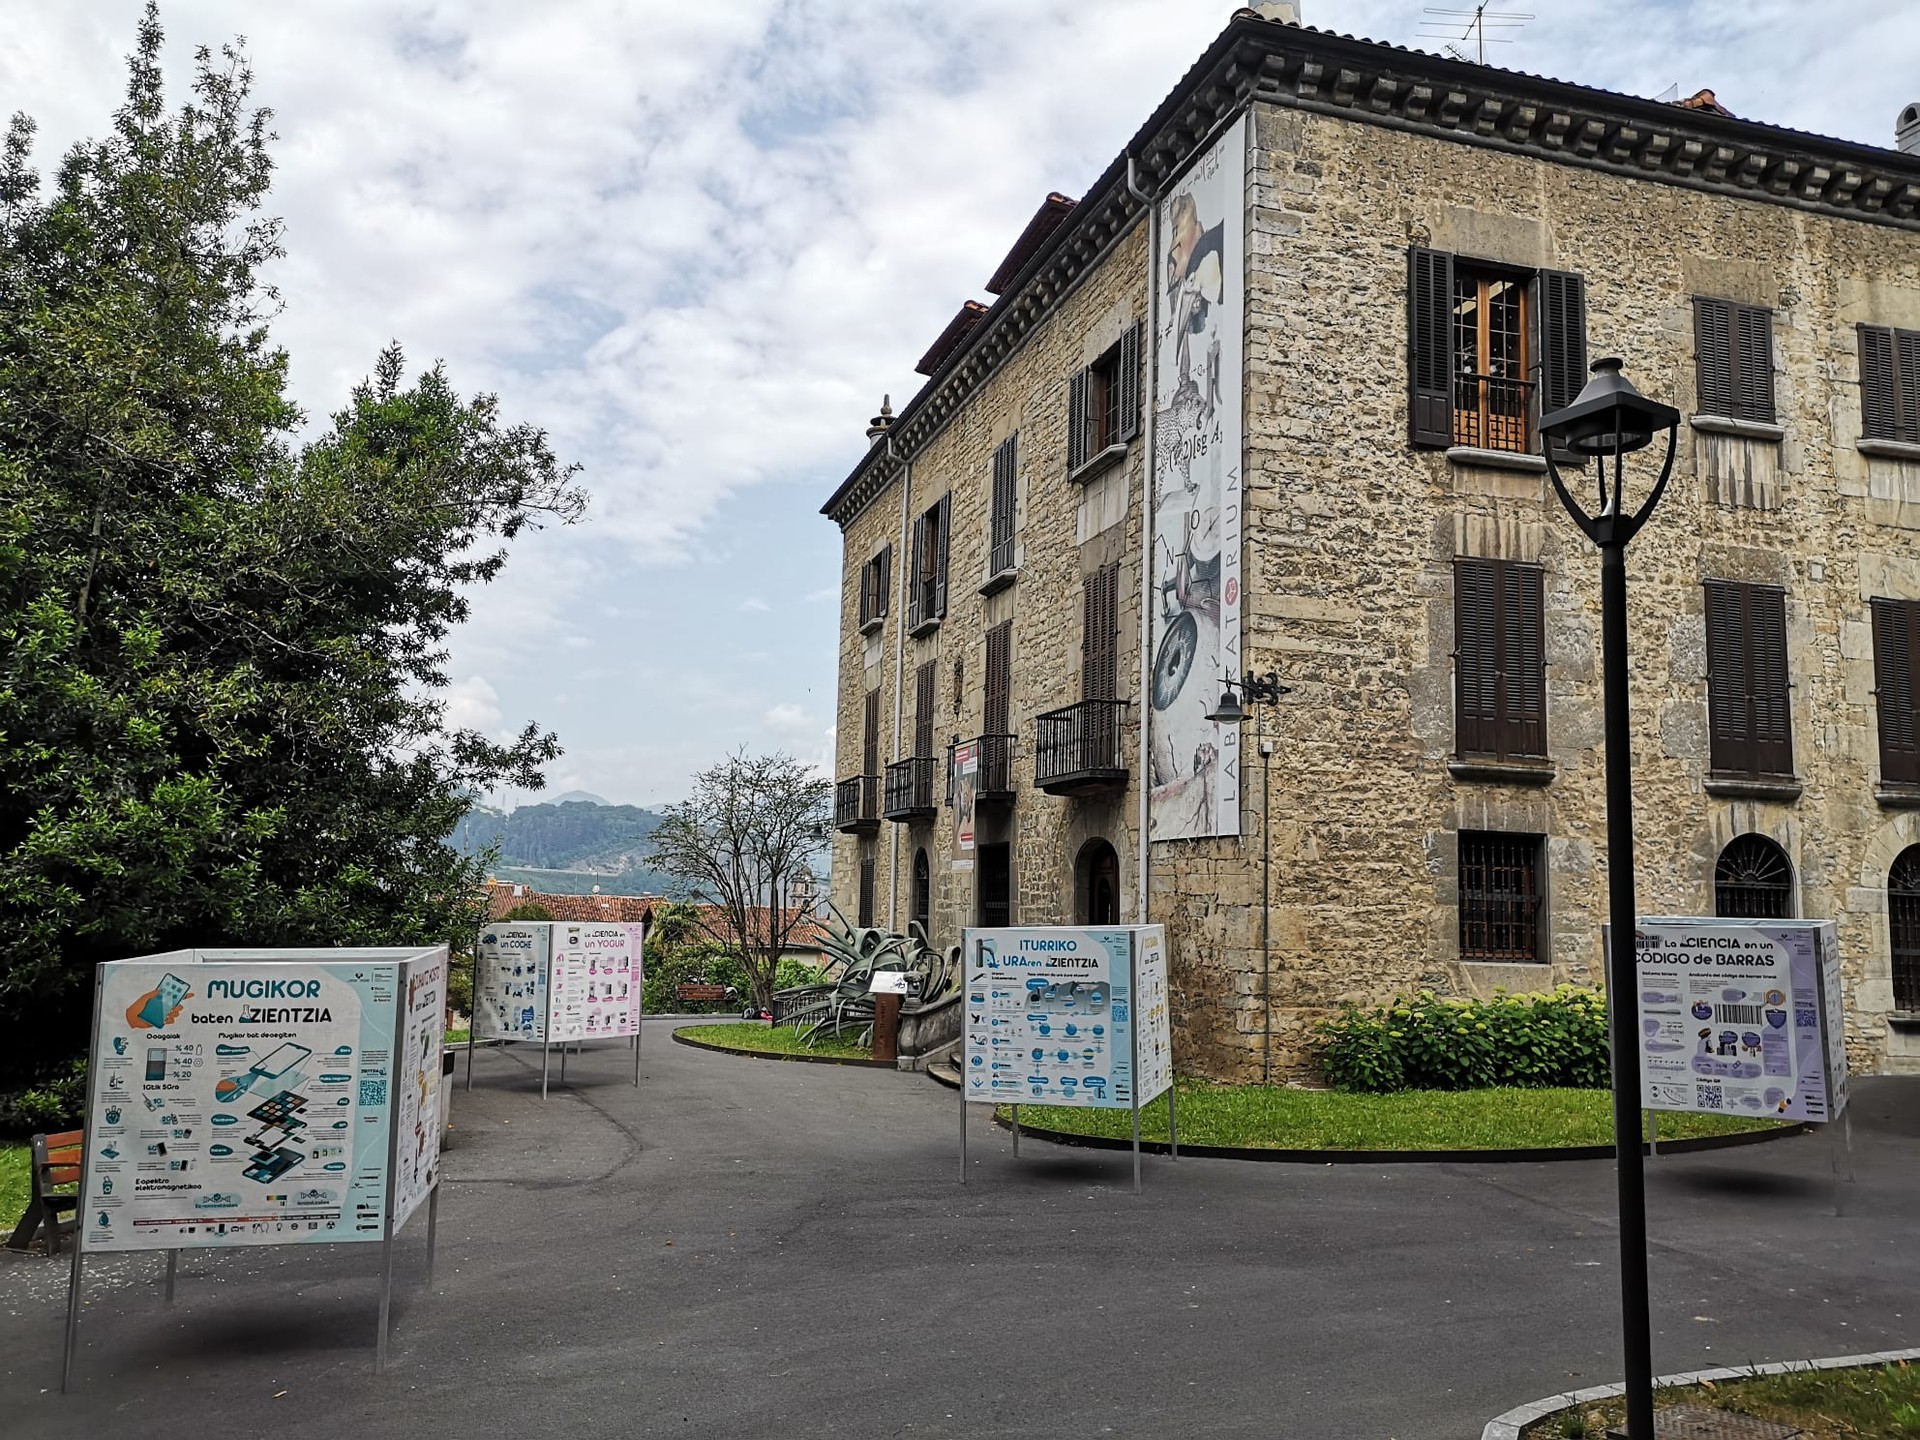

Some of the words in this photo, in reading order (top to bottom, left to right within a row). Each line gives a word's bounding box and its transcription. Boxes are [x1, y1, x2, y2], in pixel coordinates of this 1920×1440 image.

[597, 939, 625, 948] YOGUR
[1020, 939, 1077, 952] ITURRIKO
[1664, 939, 1677, 948] La
[1686, 937, 1740, 949] CIENCIA
[1760, 942, 1774, 950] un
[1002, 954, 1042, 967] URAren
[1050, 957, 1099, 969] ZIENTZIA
[1693, 953, 1713, 965] de
[1716, 953, 1775, 967] BARRAS
[206, 979, 321, 999] MUGIKOR
[191, 1012, 234, 1024] baten
[250, 1007, 332, 1024] ZIENTZIA
[183, 1044, 194, 1052] 40
